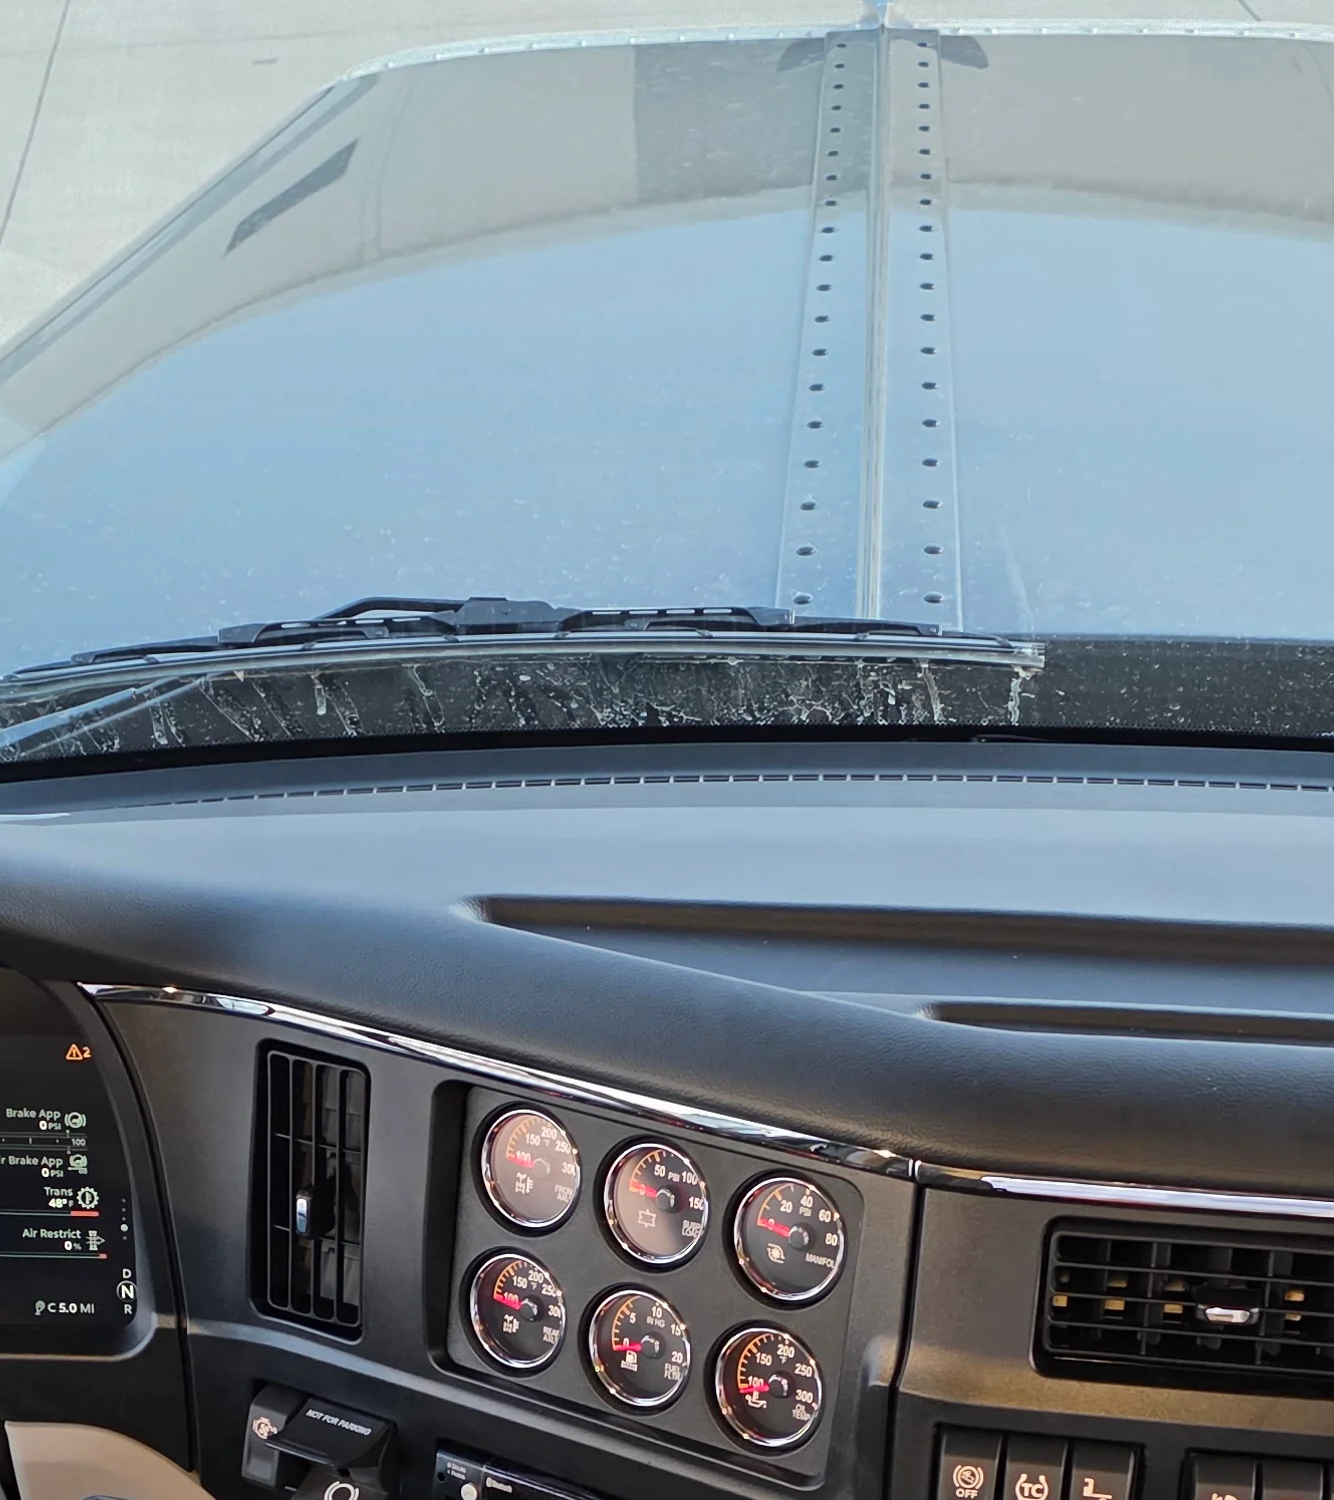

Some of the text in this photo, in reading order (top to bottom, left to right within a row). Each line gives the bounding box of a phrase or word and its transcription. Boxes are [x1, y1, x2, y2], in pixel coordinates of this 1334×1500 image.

[82, 1047, 91, 1058] 2
[6, 1108, 61, 1121] Brake App
[525, 1133, 540, 1146] 150
[541, 1126, 557, 1140] 200
[72, 1138, 86, 1146] 100
[8, 1156, 38, 1166] Brake
[41, 1157, 63, 1169] App
[654, 1164, 666, 1177] 50
[681, 1171, 699, 1185] 100
[44, 1187, 73, 1197] Trans
[780, 1200, 793, 1213] 20
[800, 1195, 813, 1208] 40
[818, 1209, 831, 1222] 60
[22, 1228, 81, 1239] Air Restrict
[825, 1233, 838, 1246] 80
[123, 1269, 132, 1279] D
[528, 1270, 544, 1283] 200
[513, 1275, 528, 1289] 150
[121, 1285, 134, 1299] N
[58, 1303, 77, 1313] 5.0
[80, 1303, 95, 1314] MI
[124, 1304, 132, 1314] R
[651, 1306, 663, 1318] 10
[629, 1312, 636, 1324] 5
[670, 1323, 681, 1336] 15
[671, 1351, 683, 1363] 20
[777, 1344, 795, 1358] 200
[755, 1352, 772, 1366] 150
[795, 1363, 812, 1377] 250
[795, 1389, 813, 1403] 300
[306, 1409, 371, 1436] NOT FOR PARKING
[956, 1489, 978, 1499] OFF
[1021, 1483, 1043, 1497] TC
